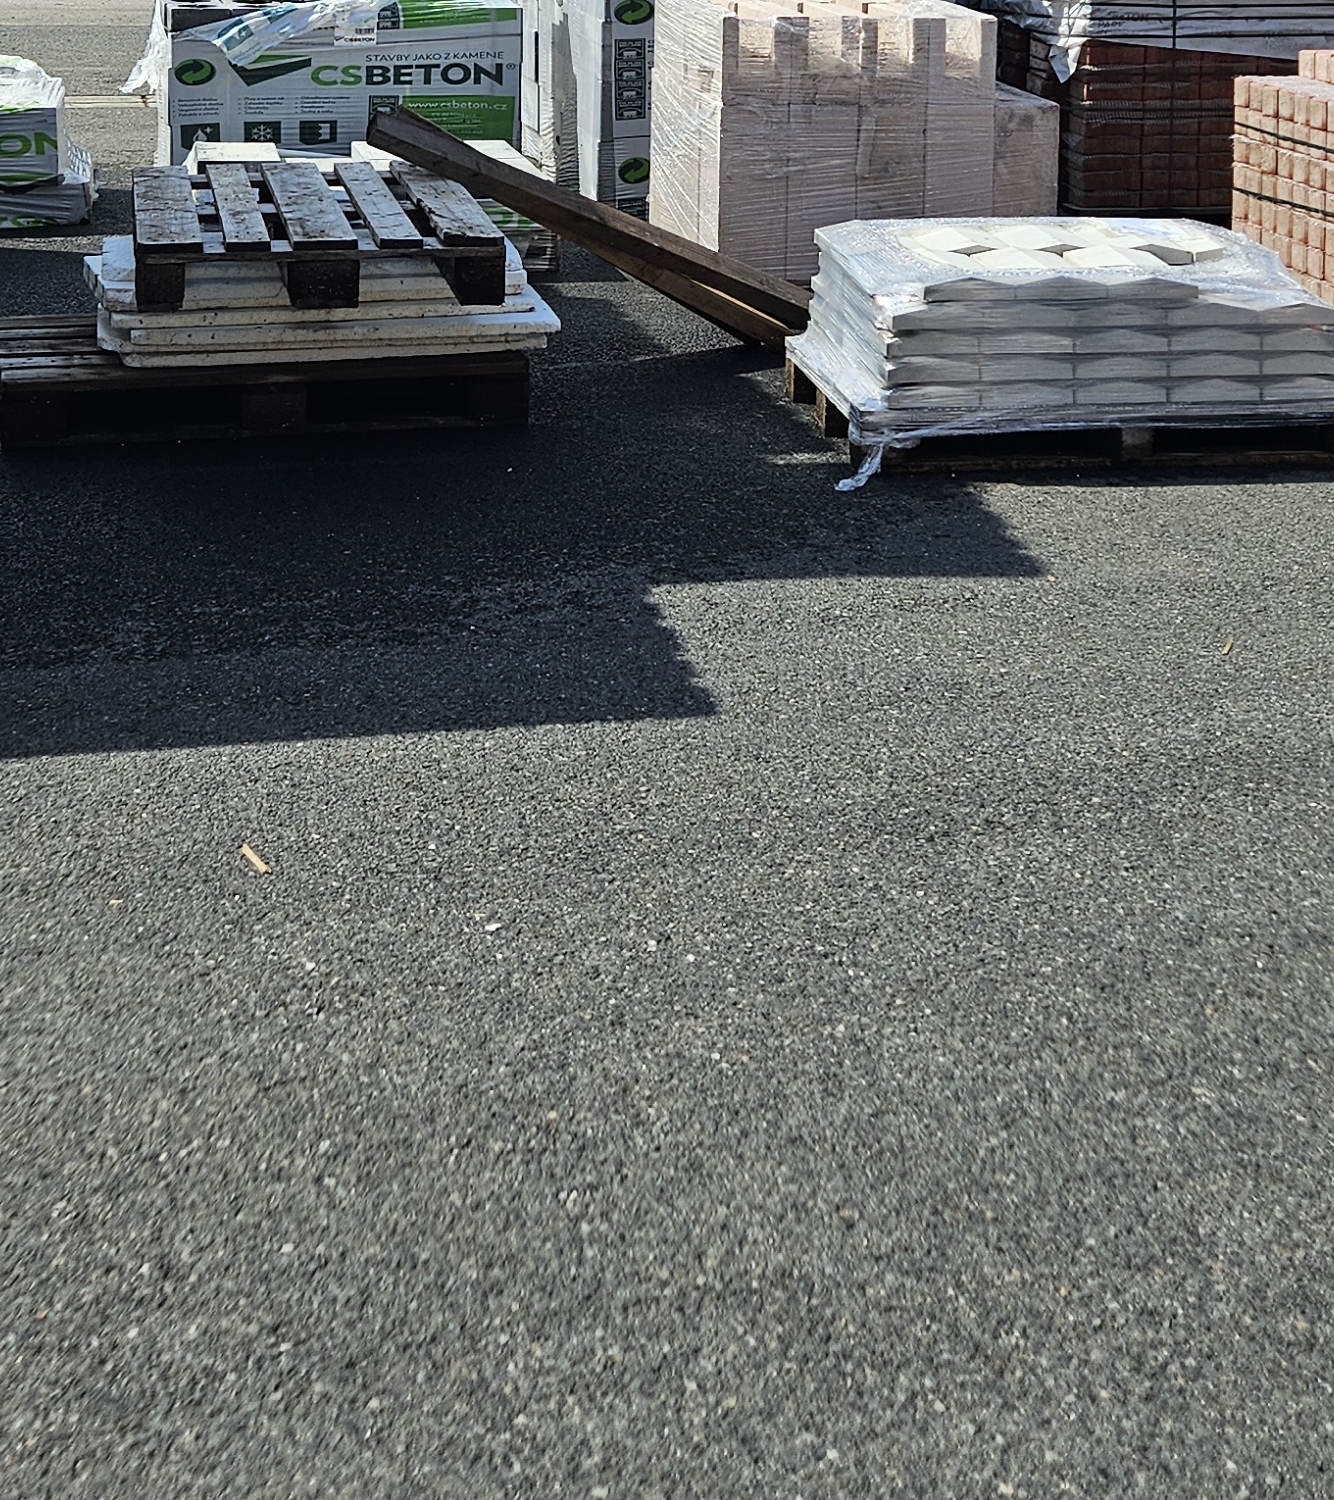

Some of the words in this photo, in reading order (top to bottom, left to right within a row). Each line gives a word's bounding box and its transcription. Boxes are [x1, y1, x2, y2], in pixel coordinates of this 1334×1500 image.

[365, 53, 410, 62] STAVBY
[412, 52, 442, 62] JAKO
[444, 52, 451, 60] Z
[453, 51, 504, 60] KAMENE
[408, 101, 507, 111] www.csbeton.cz
